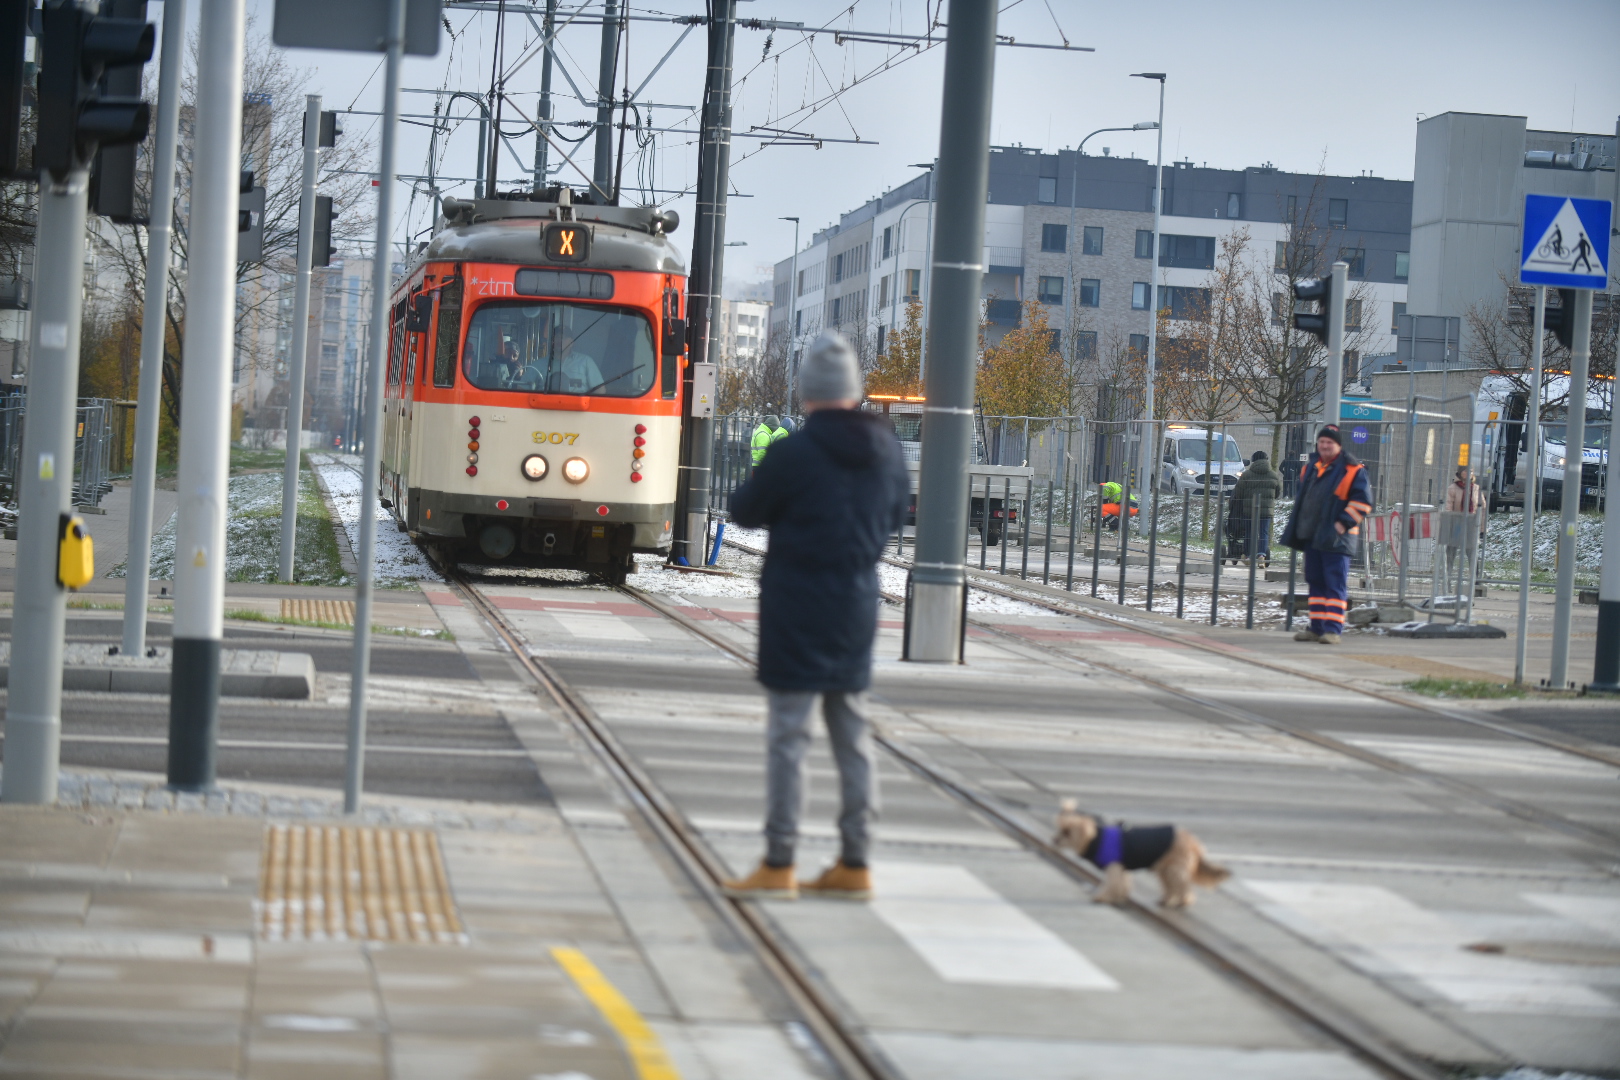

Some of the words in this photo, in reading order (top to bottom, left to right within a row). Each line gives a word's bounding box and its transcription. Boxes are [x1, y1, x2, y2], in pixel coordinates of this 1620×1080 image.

[560, 230, 574, 255] X
[531, 431, 579, 446] 907
[1353, 431, 1367, 439] R10
